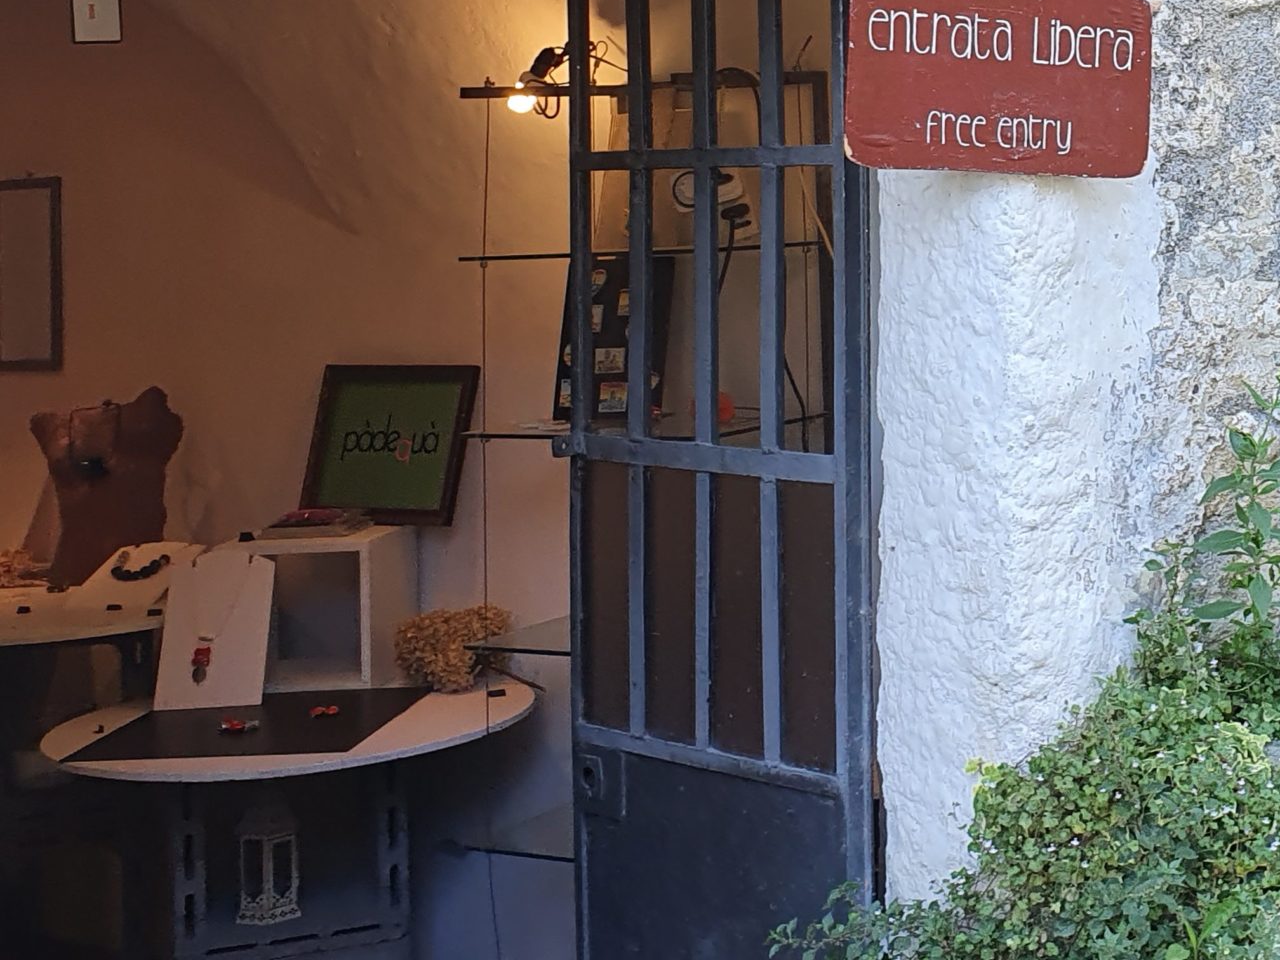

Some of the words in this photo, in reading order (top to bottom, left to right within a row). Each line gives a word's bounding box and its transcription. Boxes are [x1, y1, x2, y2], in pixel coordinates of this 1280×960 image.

[868, 9, 1012, 61] entrata
[1033, 16, 1133, 71] Libera
[925, 110, 987, 148] free
[996, 115, 1073, 156] entry
